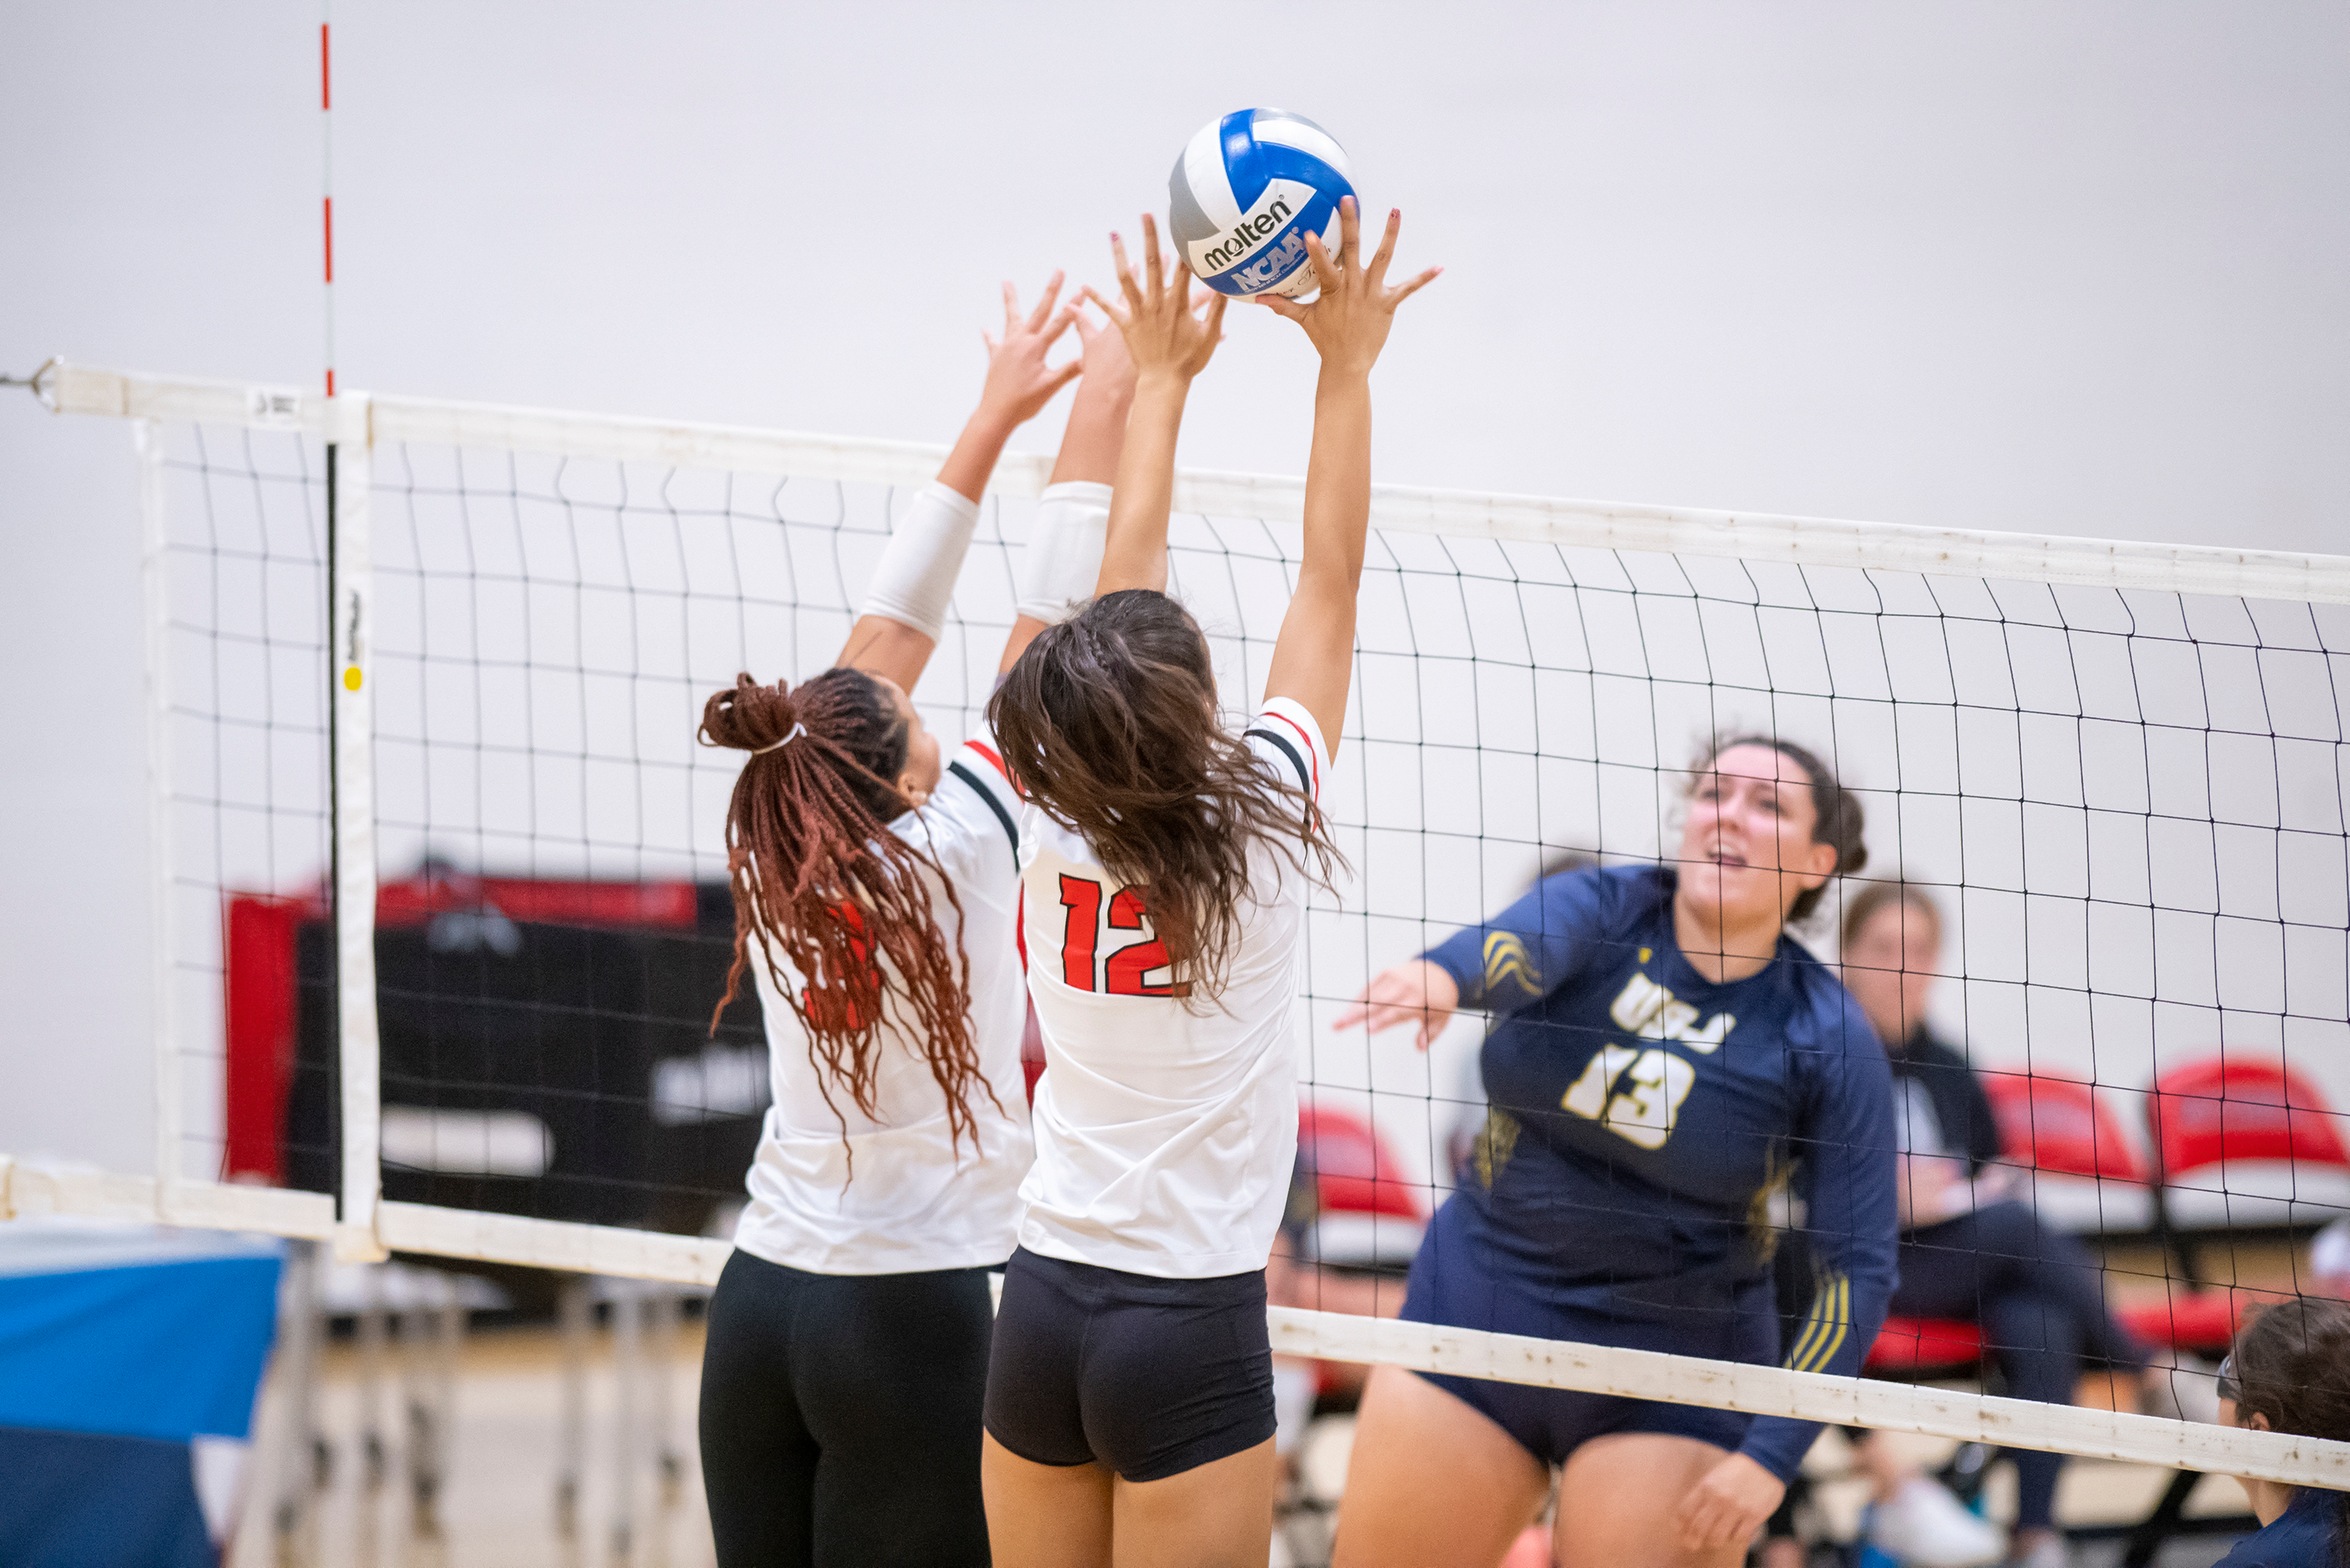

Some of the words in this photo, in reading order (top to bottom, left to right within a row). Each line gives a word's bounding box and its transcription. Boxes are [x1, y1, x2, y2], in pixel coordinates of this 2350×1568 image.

[1204, 200, 1292, 271] molten
[1230, 231, 1304, 292] NCAA
[1059, 872, 1192, 997] 12
[1561, 1043, 1696, 1150] 13
